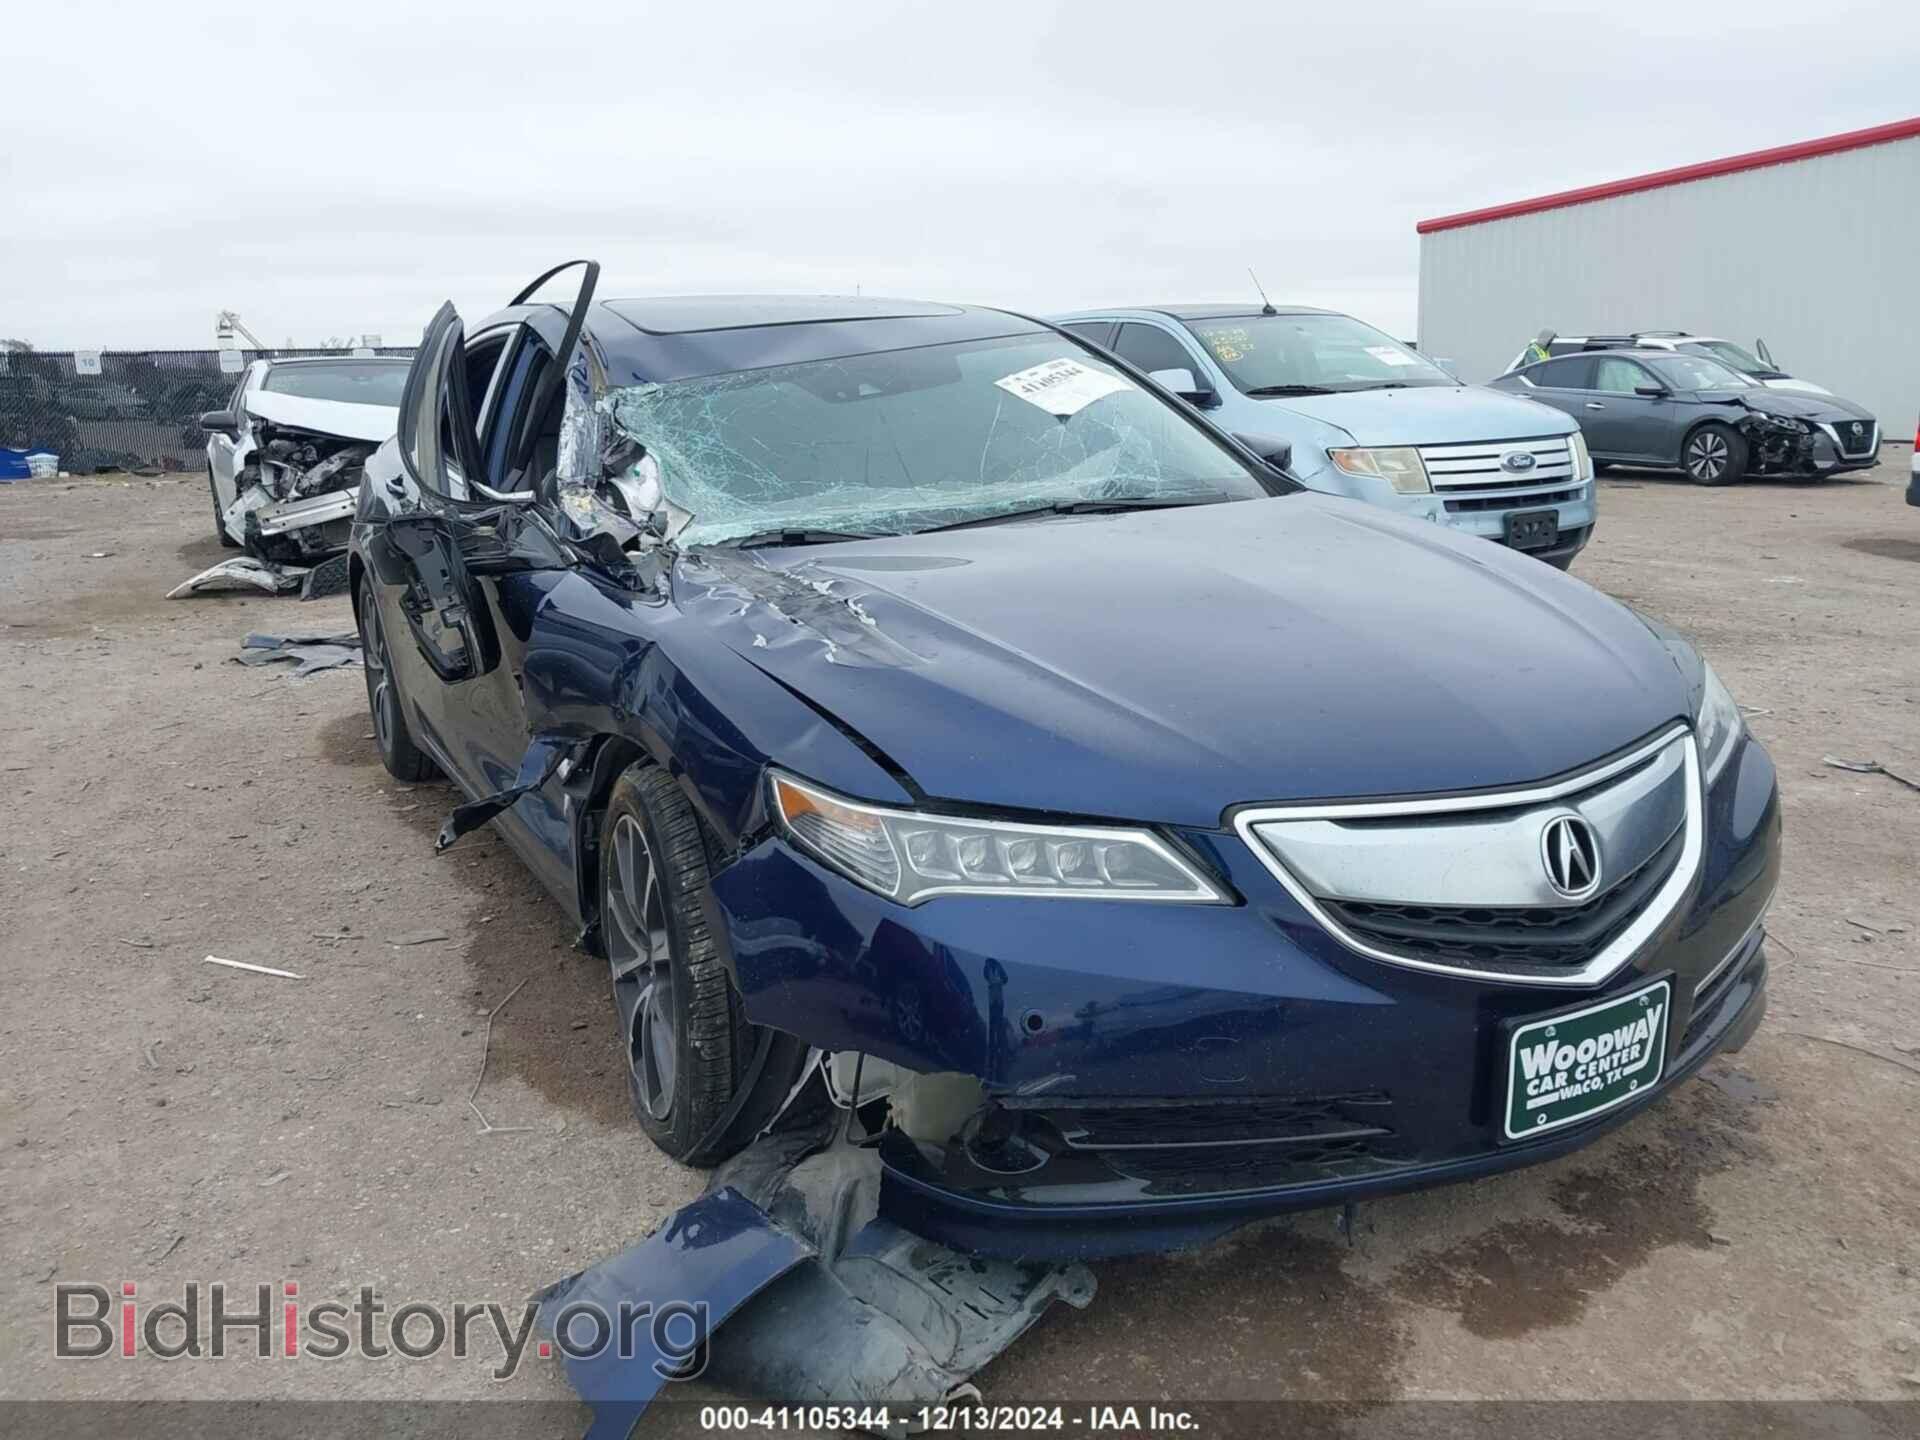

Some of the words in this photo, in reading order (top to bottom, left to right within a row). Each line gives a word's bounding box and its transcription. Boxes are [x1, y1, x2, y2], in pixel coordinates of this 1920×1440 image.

[1520, 1003, 1663, 1080] WOODWAY
[1526, 1071, 1568, 1097] CAR
[1574, 1043, 1641, 1080] CENTER
[1558, 1077, 1604, 1100] WACO,
[1607, 1069, 1623, 1086] TX
